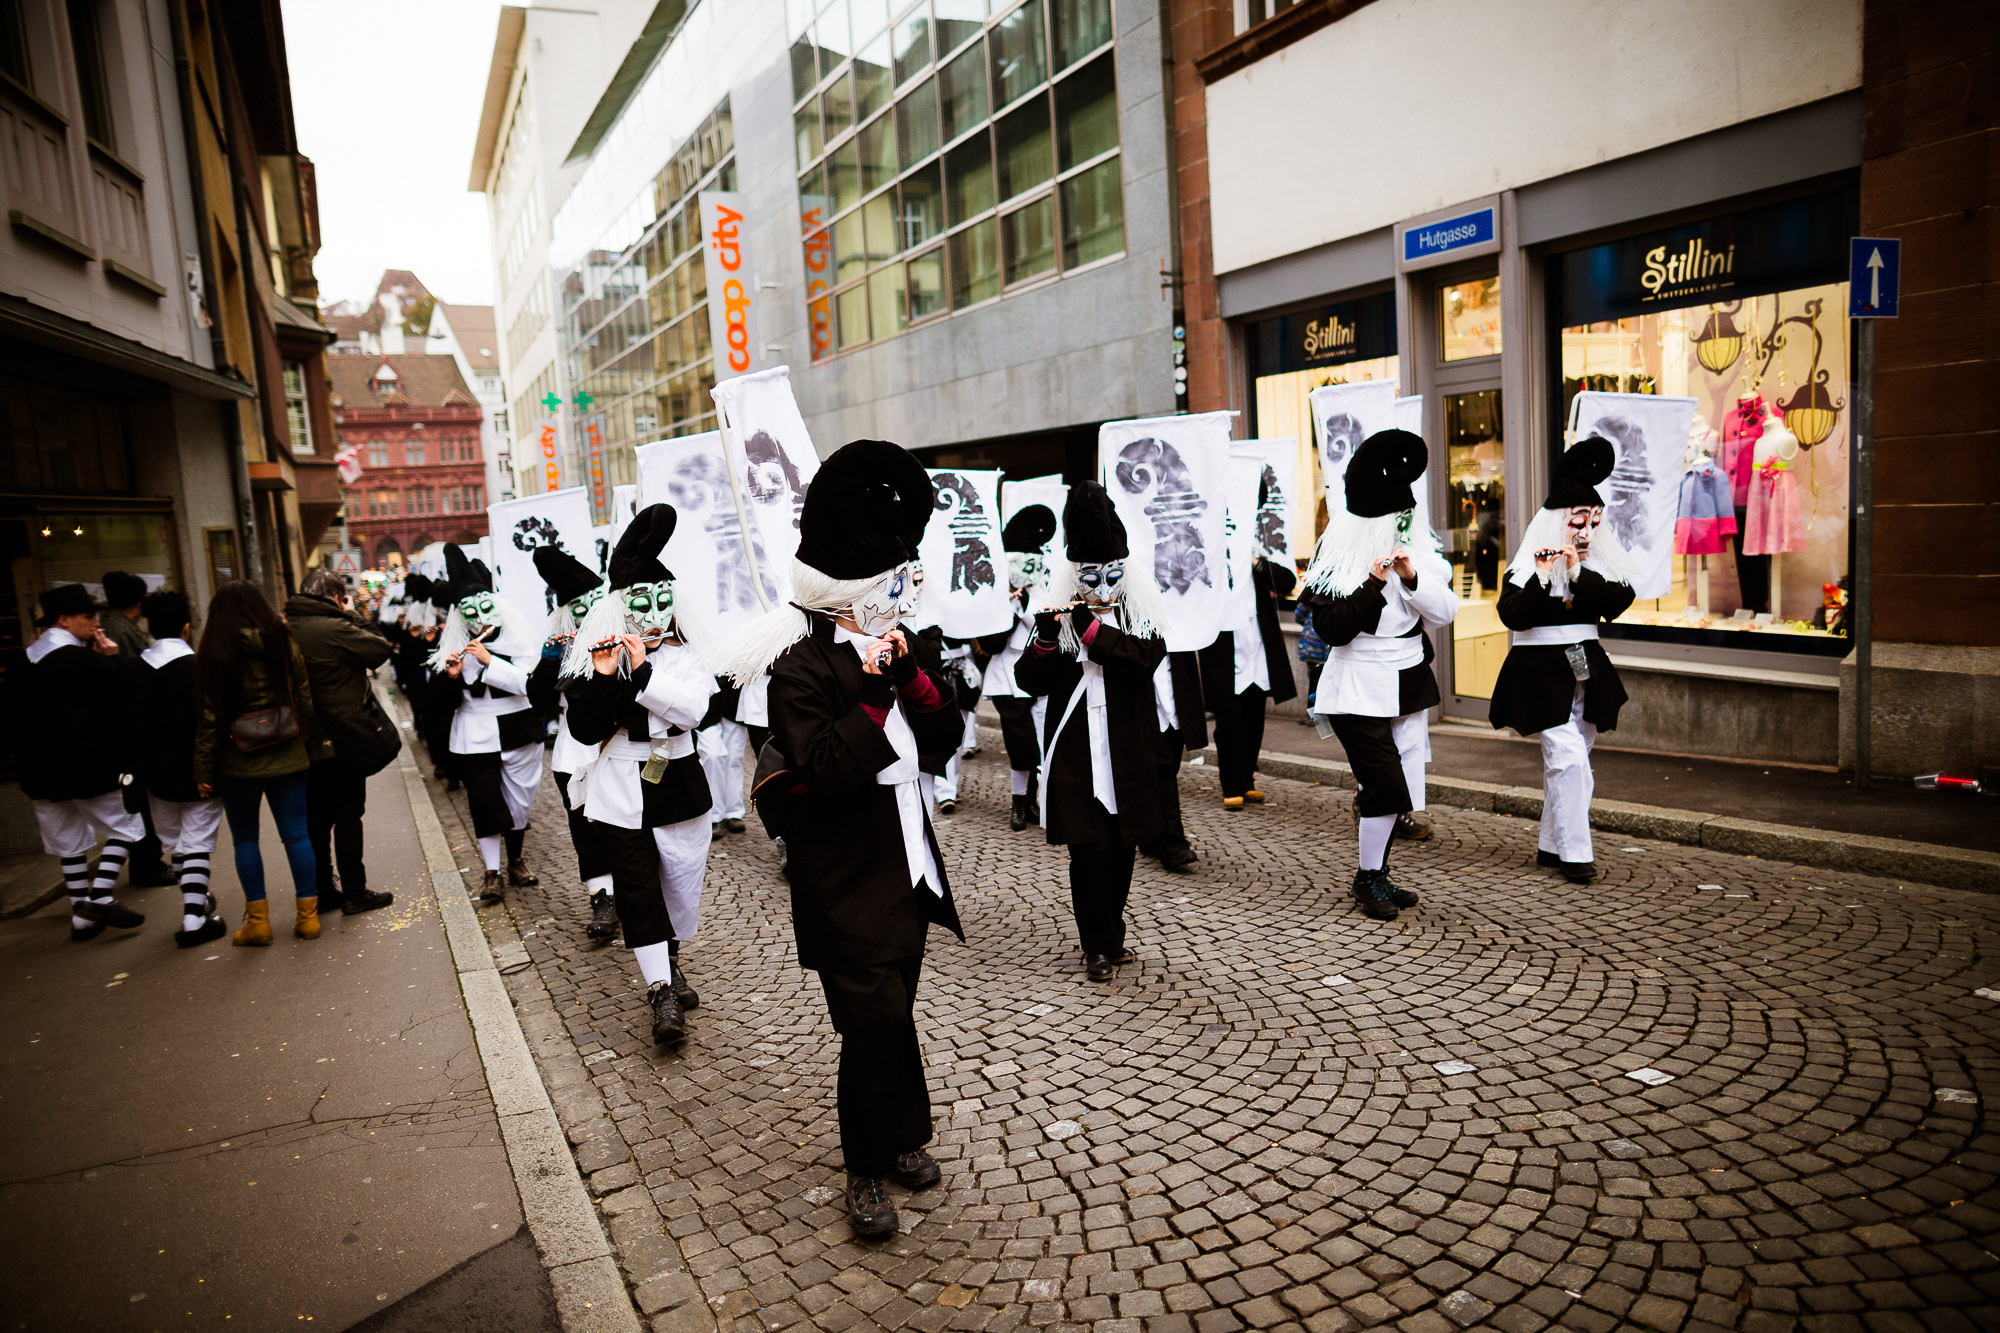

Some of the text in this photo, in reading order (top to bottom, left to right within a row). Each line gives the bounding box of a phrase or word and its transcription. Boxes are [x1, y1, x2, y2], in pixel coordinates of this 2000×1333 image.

[1418, 223, 1477, 250] Hutgasse
[1640, 237, 1736, 295] Stillini
[711, 204, 751, 372] coop city
[1656, 283, 1718, 300] SWITZERLAND
[1303, 315, 1356, 356] Stillini
[538, 424, 557, 459] city
